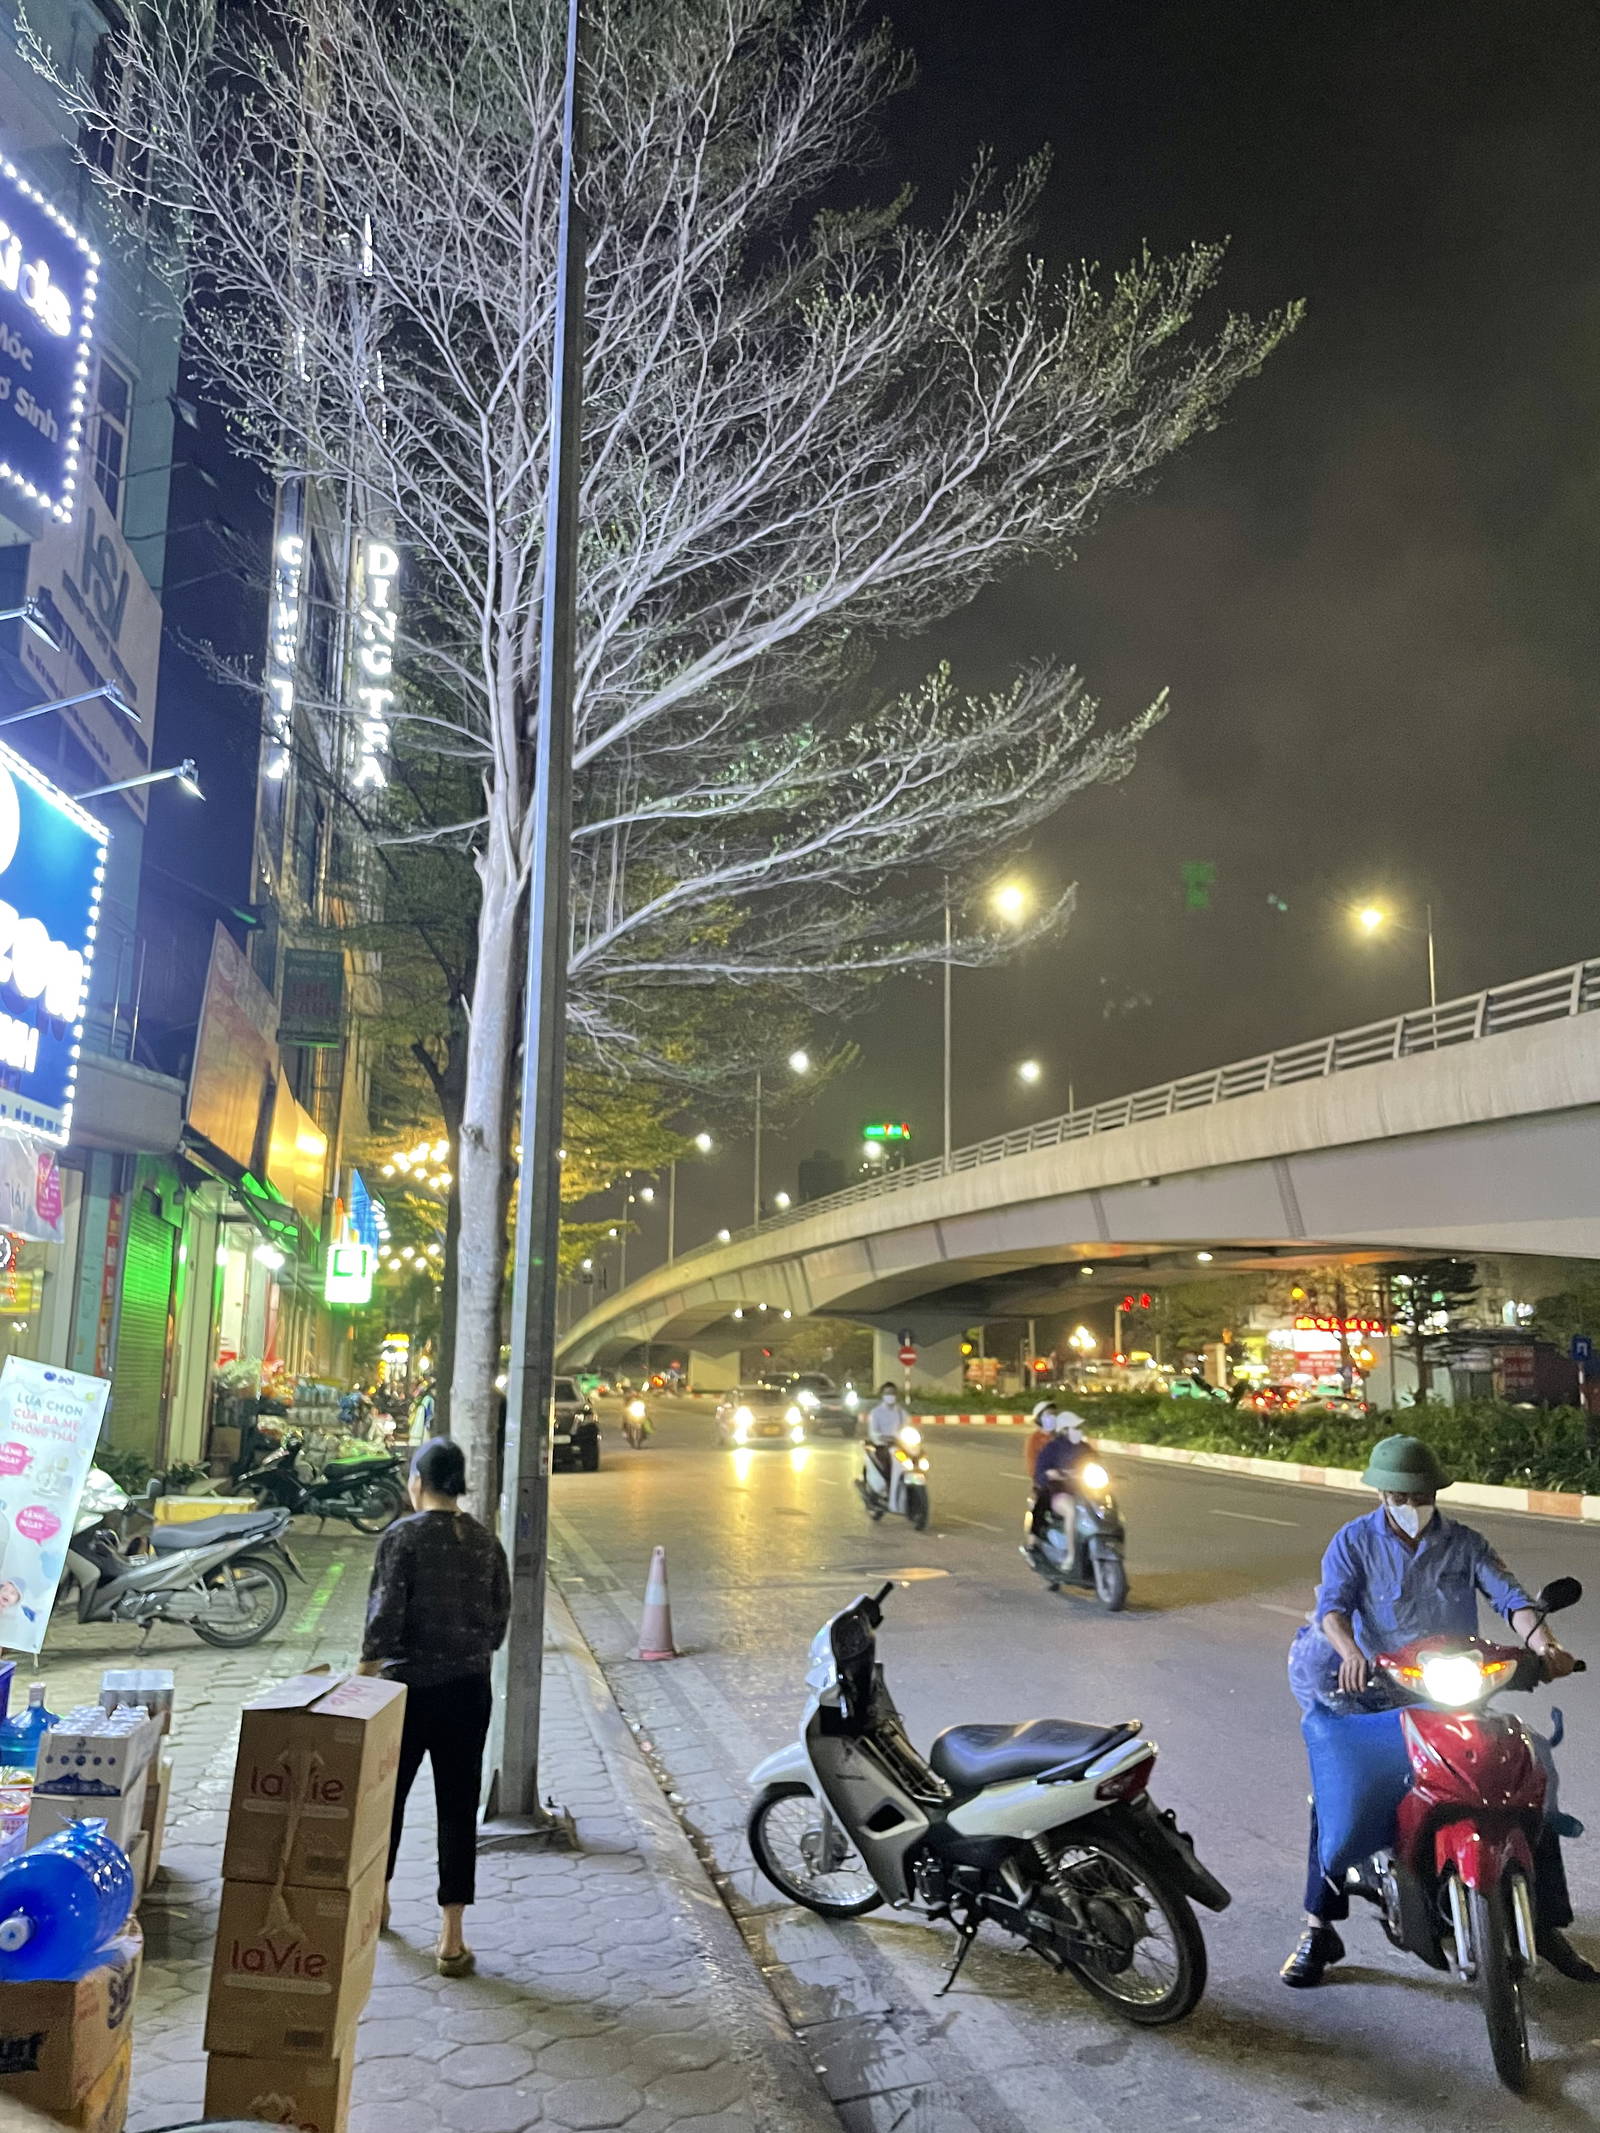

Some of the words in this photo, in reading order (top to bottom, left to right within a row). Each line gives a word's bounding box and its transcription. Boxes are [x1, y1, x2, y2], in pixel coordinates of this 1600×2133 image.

[15, 387, 59, 443] Sinh
[360, 544, 399, 675] DING
[353, 688, 394, 788] TEA
[230, 1937, 328, 1978] laVie
